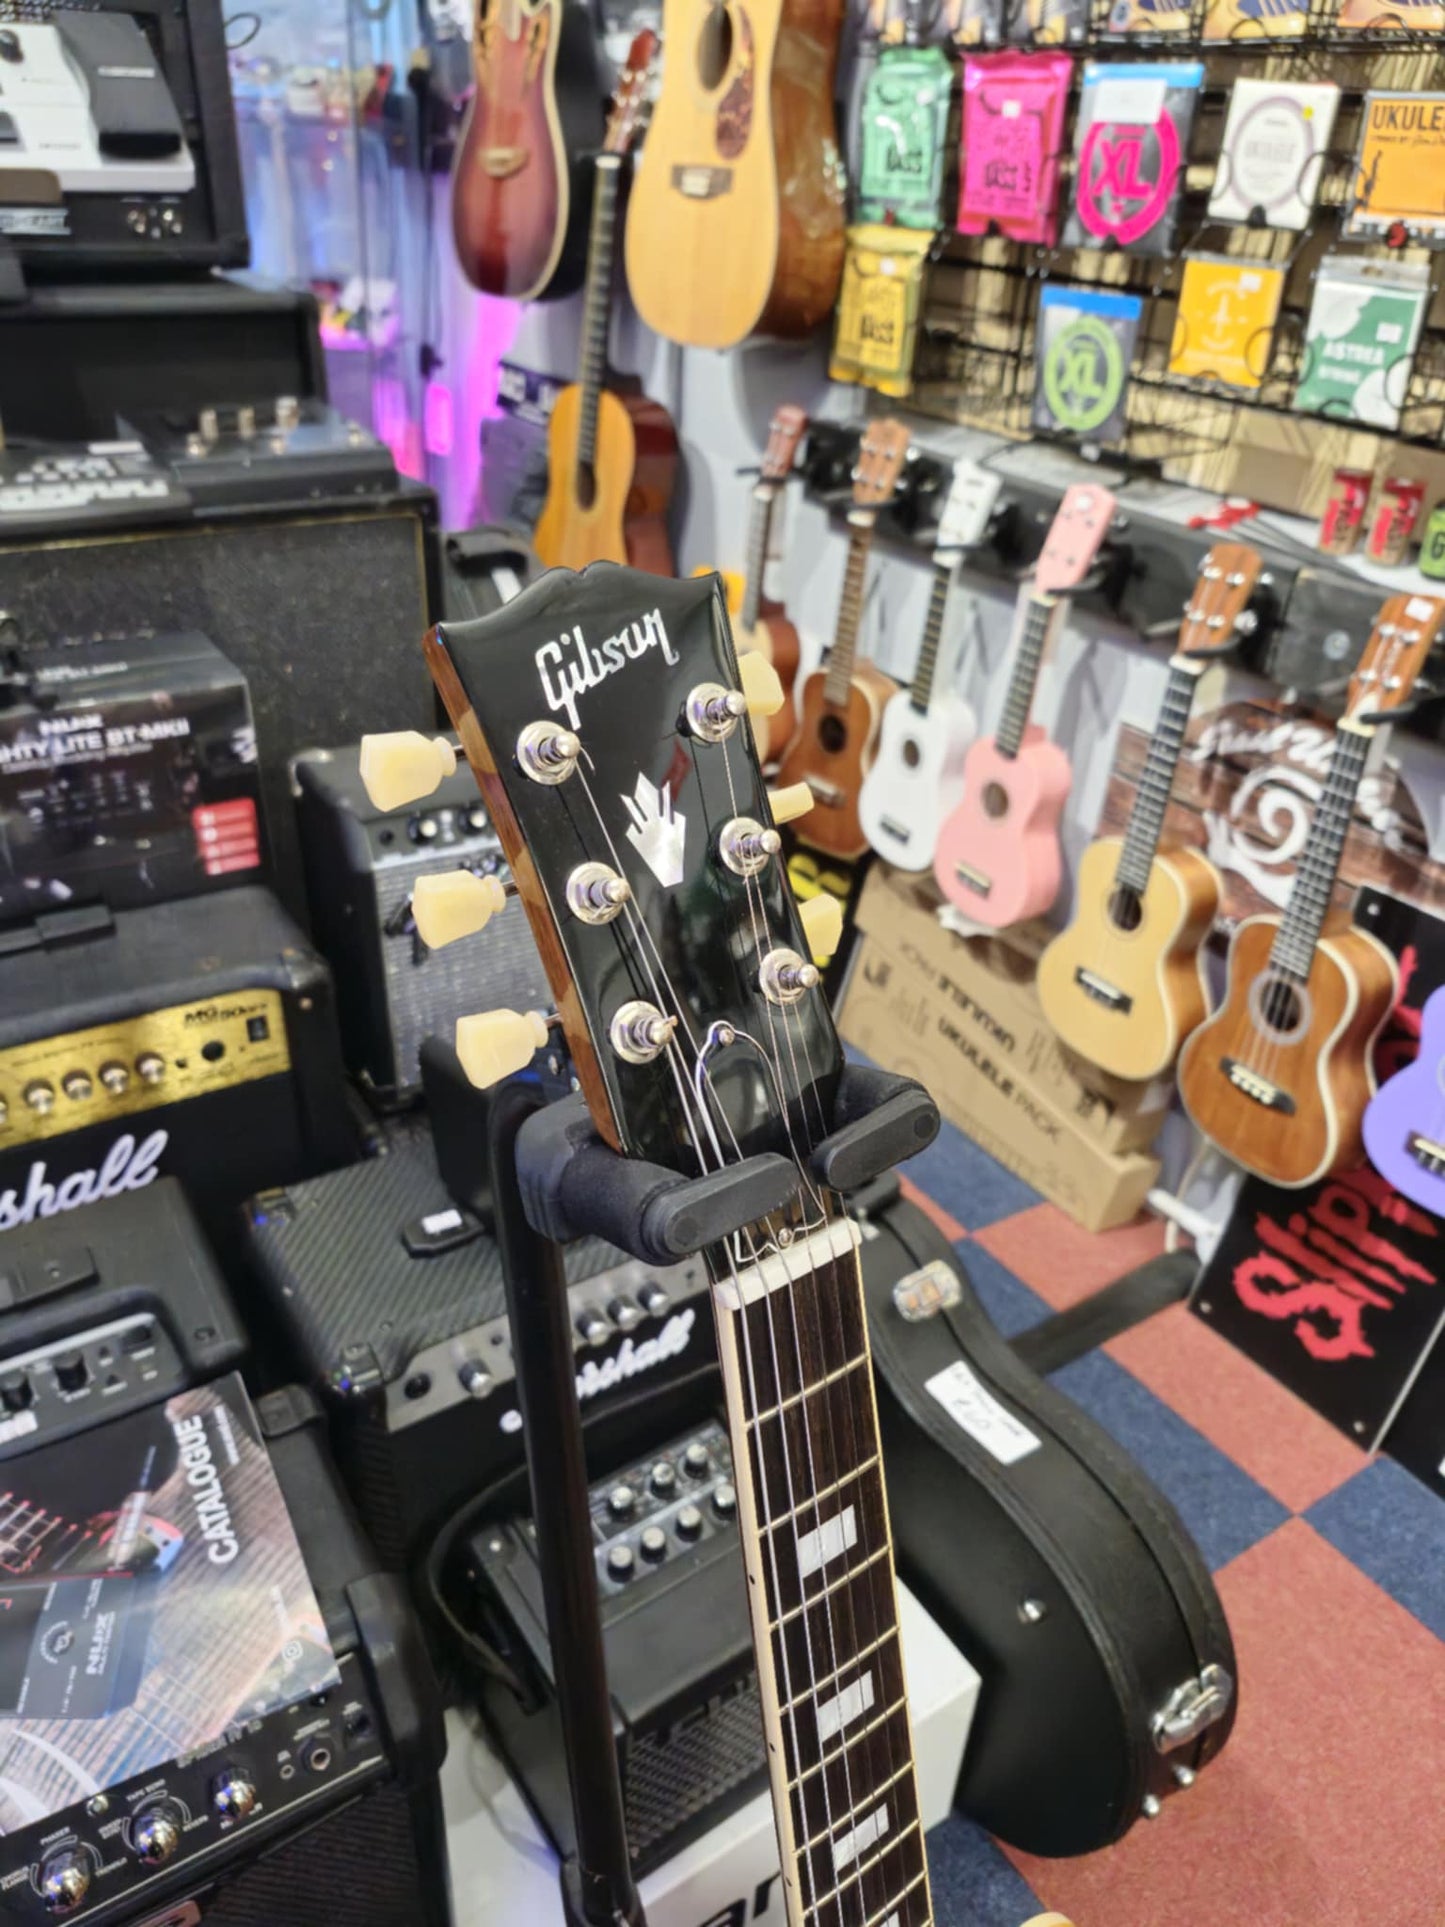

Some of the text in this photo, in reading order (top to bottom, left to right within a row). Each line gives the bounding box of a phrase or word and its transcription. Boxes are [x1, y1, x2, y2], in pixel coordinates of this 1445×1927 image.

[1372, 104, 1445, 131] UKULE
[535, 607, 679, 731] Gibson
[937, 1015, 1014, 1098] UKULELE
[172, 1414, 240, 1565] CATALOGUE
